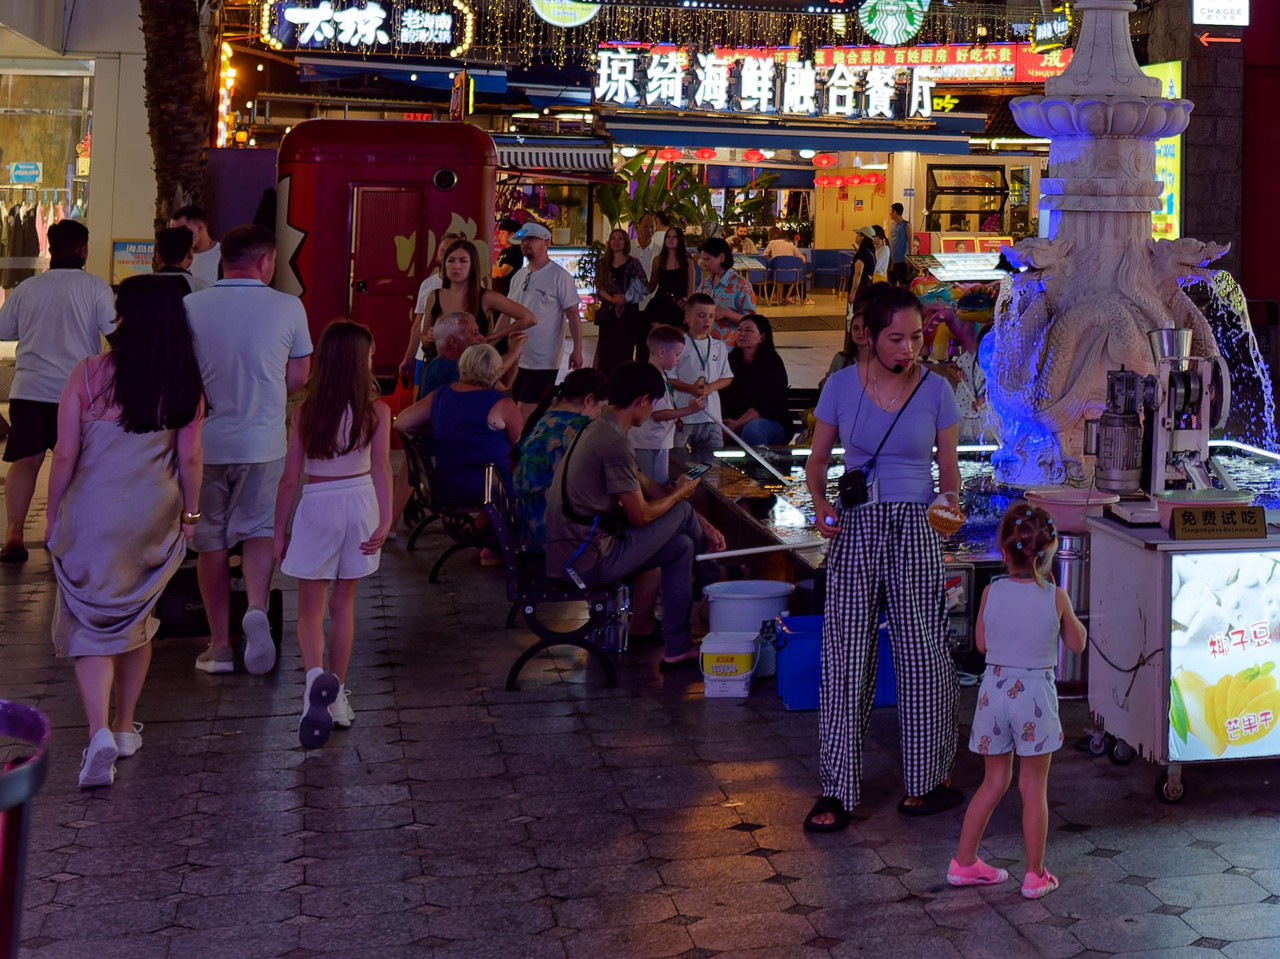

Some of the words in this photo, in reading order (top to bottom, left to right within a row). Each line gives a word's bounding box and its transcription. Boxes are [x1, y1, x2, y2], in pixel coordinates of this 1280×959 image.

[1200, 7, 1242, 16] CHAGEE
[832, 49, 885, 65] 融合菜馆
[894, 48, 947, 64] 百姓厨房
[955, 46, 1011, 63] 好吃不贵
[596, 47, 936, 119] 琼绮海鲜融合餐厅
[1181, 510, 1257, 526] 免费试吃
[1208, 621, 1271, 659] 椰子豆
[1225, 711, 1273, 740] 芒果干
